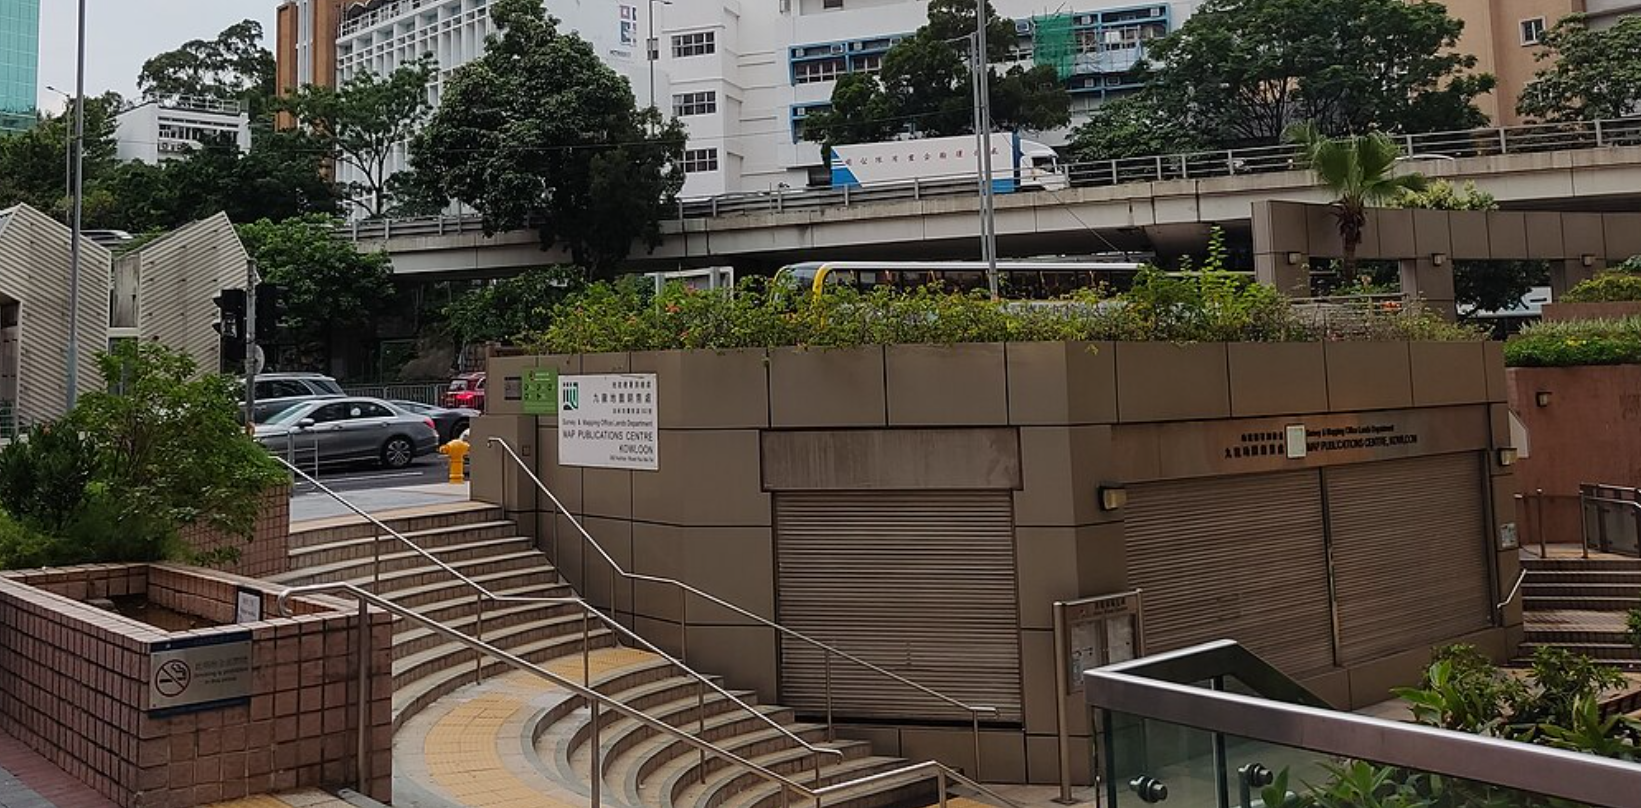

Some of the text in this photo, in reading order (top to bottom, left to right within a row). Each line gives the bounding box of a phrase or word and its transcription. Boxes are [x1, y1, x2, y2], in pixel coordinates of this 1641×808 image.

[563, 430, 653, 442] MAP PUBLICATIONS CENTRE
[619, 444, 653, 455] KOWLOON
